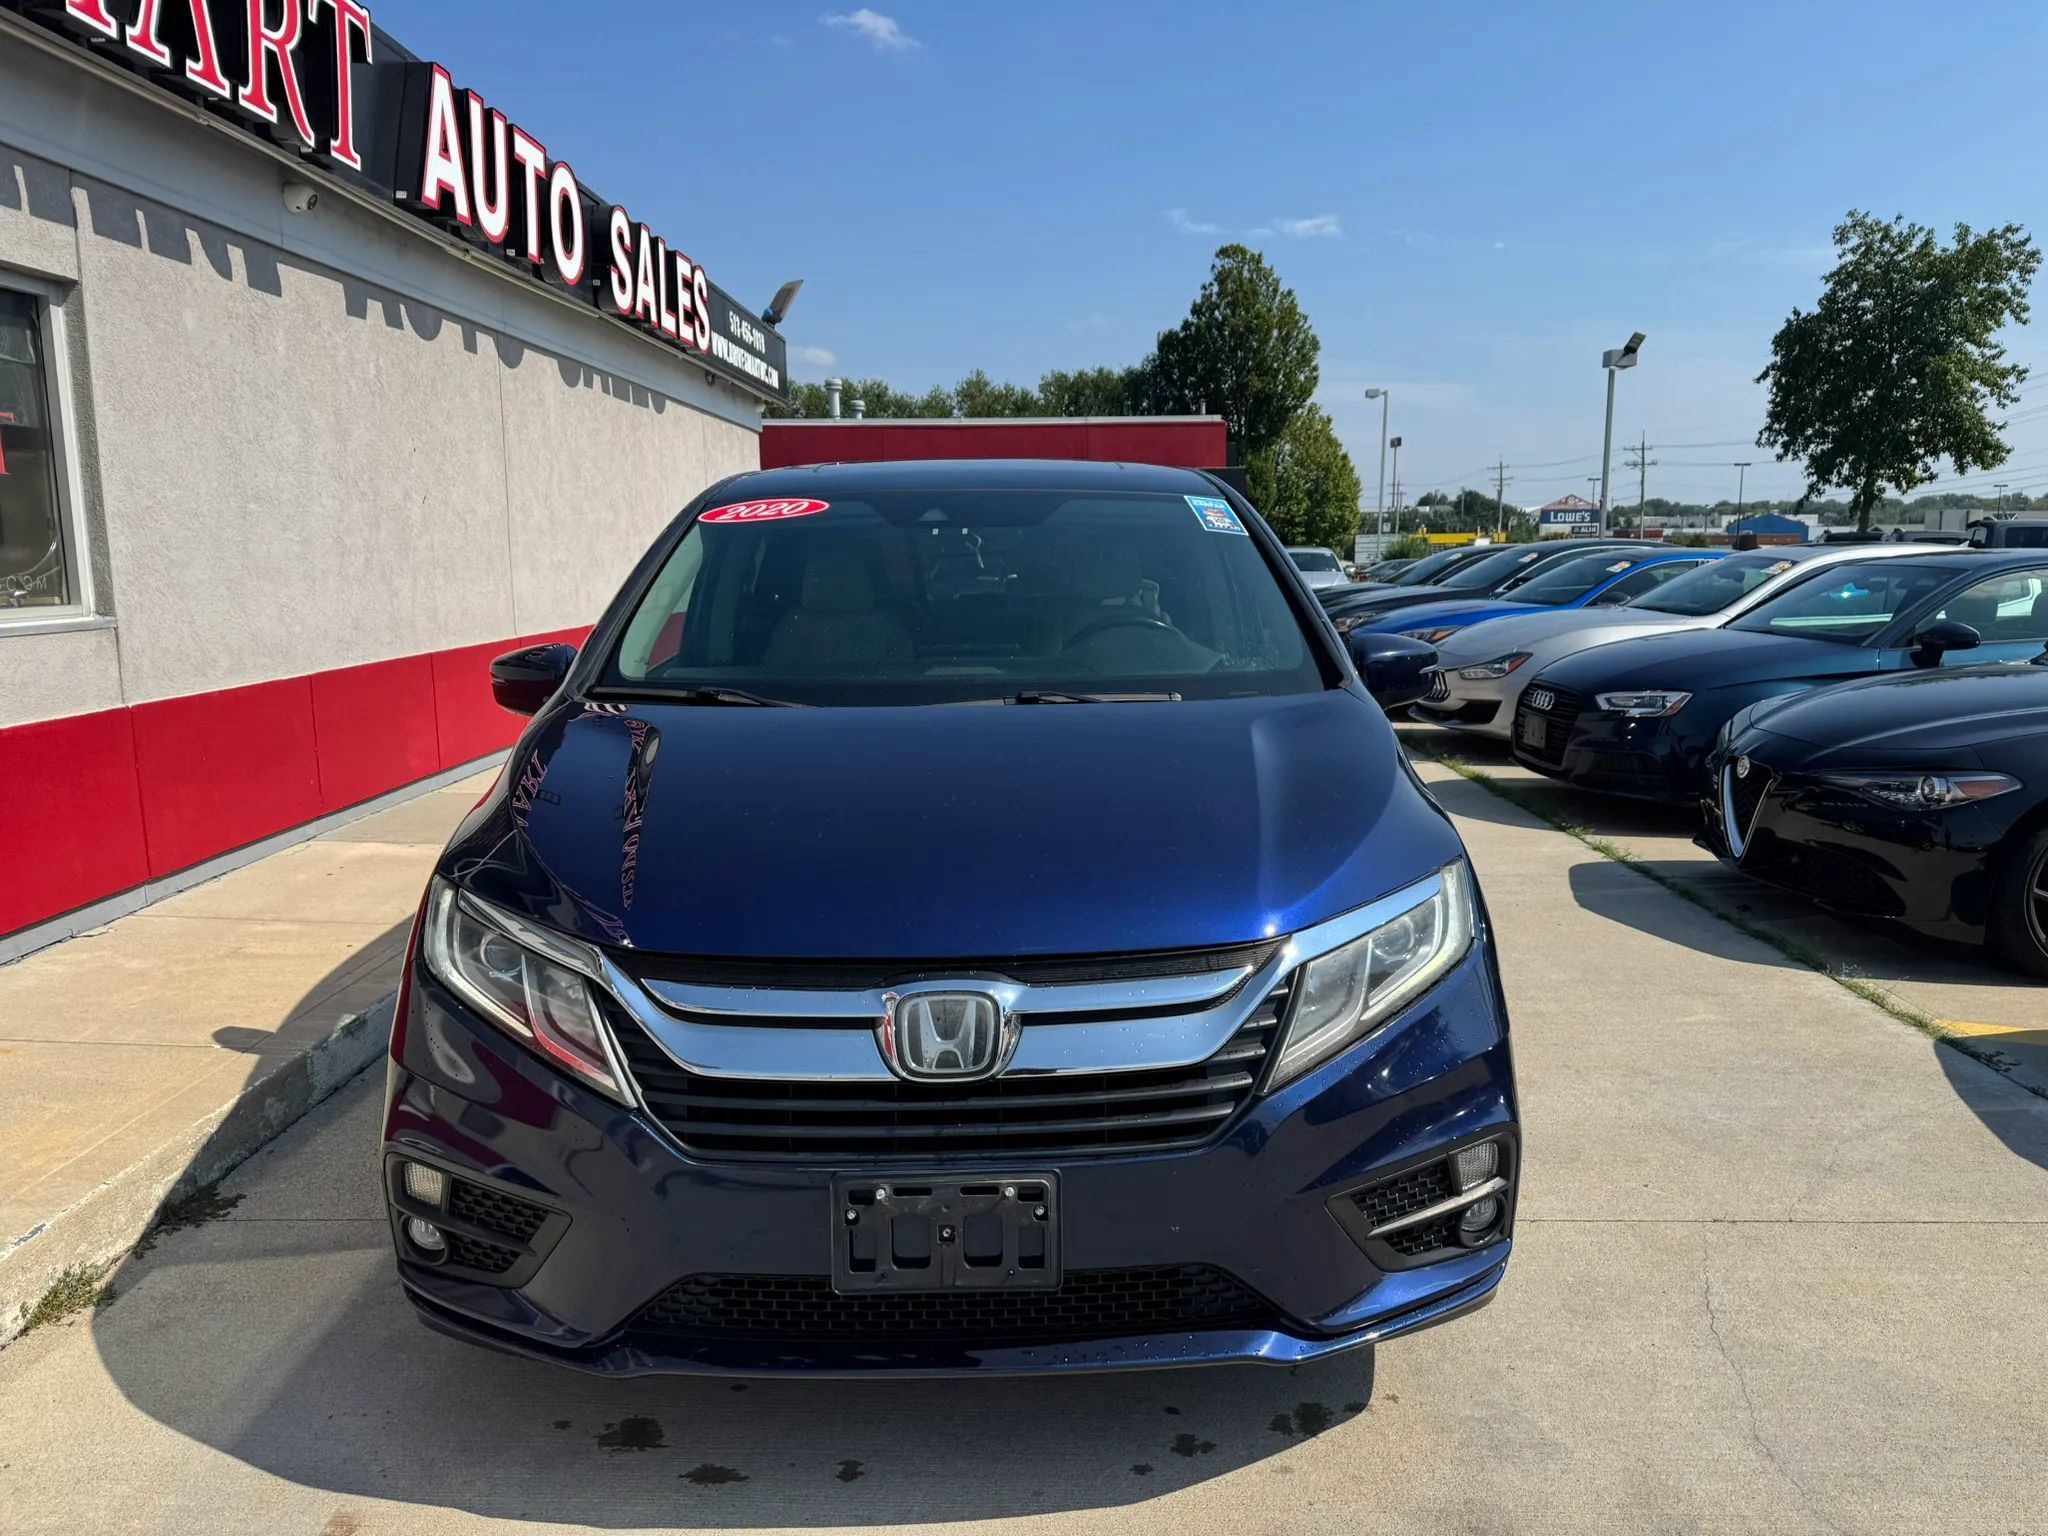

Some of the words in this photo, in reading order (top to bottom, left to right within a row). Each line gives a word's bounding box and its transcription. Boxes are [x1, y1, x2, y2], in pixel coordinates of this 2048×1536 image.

[421, 63, 584, 286] AUTO
[610, 204, 711, 356] SALES
[715, 501, 810, 521] 2020
